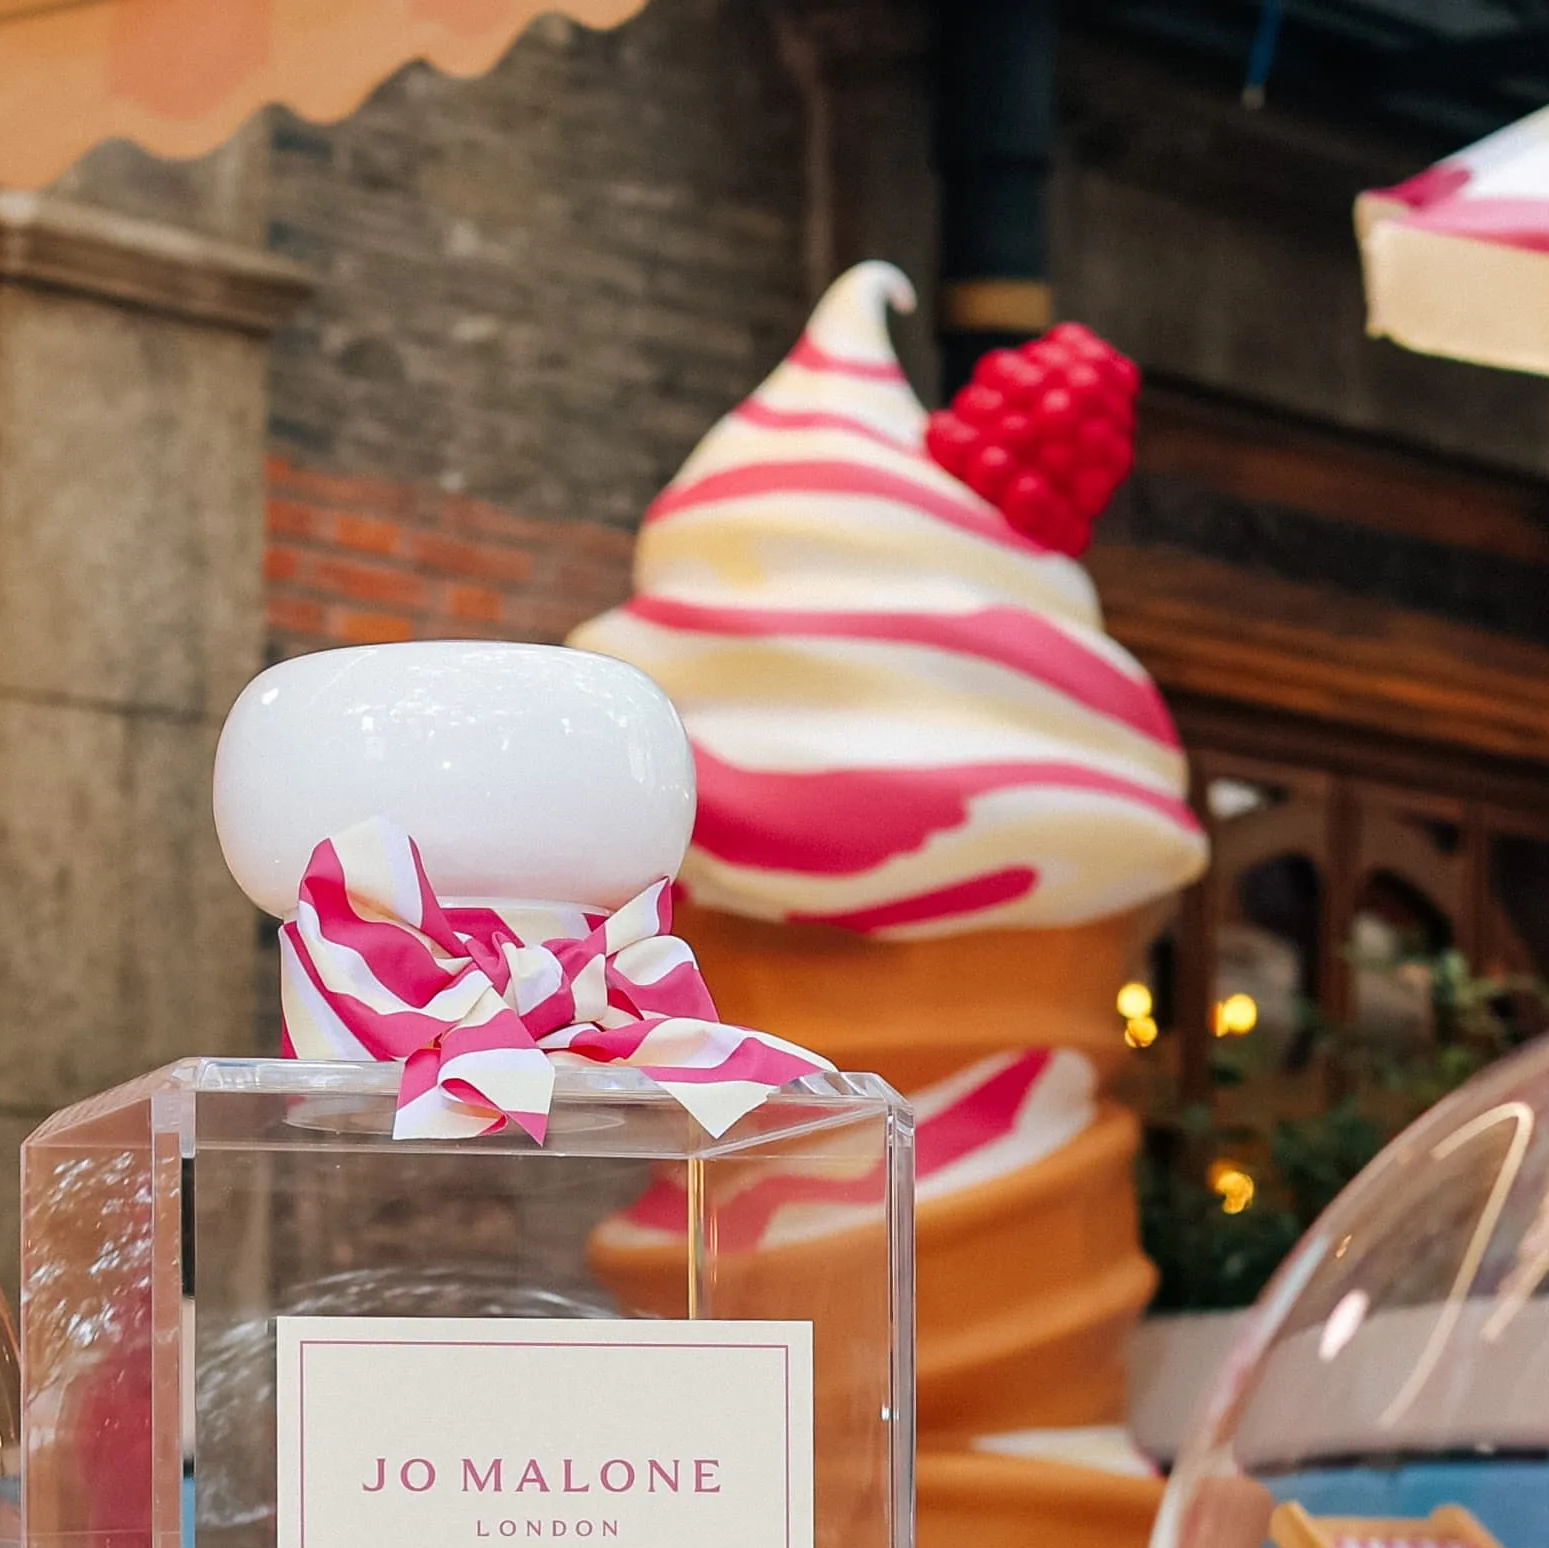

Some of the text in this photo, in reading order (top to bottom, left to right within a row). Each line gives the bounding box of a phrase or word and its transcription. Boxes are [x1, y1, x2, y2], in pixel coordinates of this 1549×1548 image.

[361, 1457, 722, 1494] JO MALONE
[476, 1519, 619, 1538] LONDON
